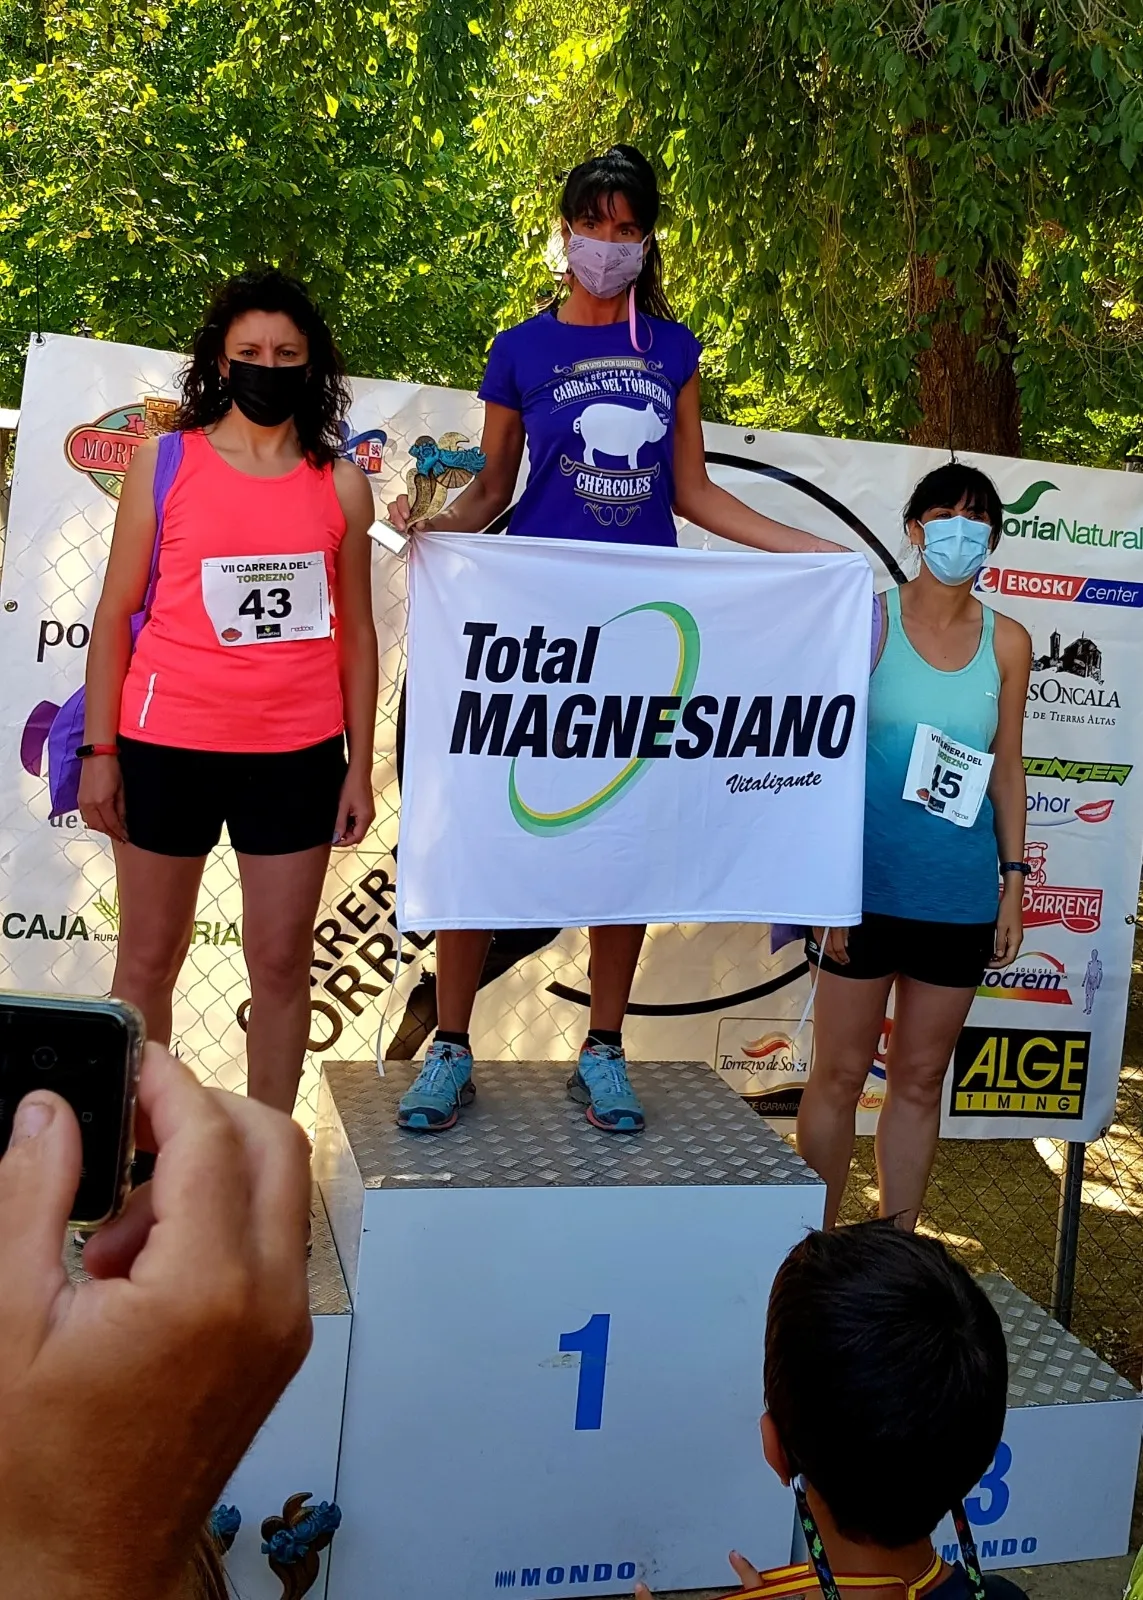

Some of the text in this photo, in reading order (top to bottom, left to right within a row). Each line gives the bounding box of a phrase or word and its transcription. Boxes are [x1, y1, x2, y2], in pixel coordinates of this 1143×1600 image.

[553, 377, 671, 410] CARRERA DEL TORREZNO
[576, 472, 651, 497] CHÉRCOLES
[221, 561, 308, 573] VII CARRERA DEL
[237, 573, 294, 583] TORREZNO
[1006, 574, 1073, 597] EROSKI
[1084, 586, 1139, 603] center
[238, 587, 292, 621] 43
[462, 621, 601, 684] Total
[448, 690, 856, 760] MAGNESIANO
[1033, 711, 1046, 720] DE
[1049, 711, 1085, 724] TIERRAS
[1087, 714, 1117, 726] ALTAS
[966, 754, 983, 766] DEL
[726, 769, 823, 794] Vitalizante
[1022, 886, 1101, 918] BARRENA
[2, 912, 90, 941] CAJA
[1015, 967, 1053, 975] SOLUGEL
[719, 1054, 808, 1075] Torrezno de Soria
[958, 1036, 1086, 1091] ALGE
[966, 1093, 1071, 1111] TIMING
[558, 1313, 611, 1431] 1
[964, 1440, 1013, 1526] 3
[941, 1536, 1038, 1562] MNDO
[520, 1561, 636, 1587] MONDO
